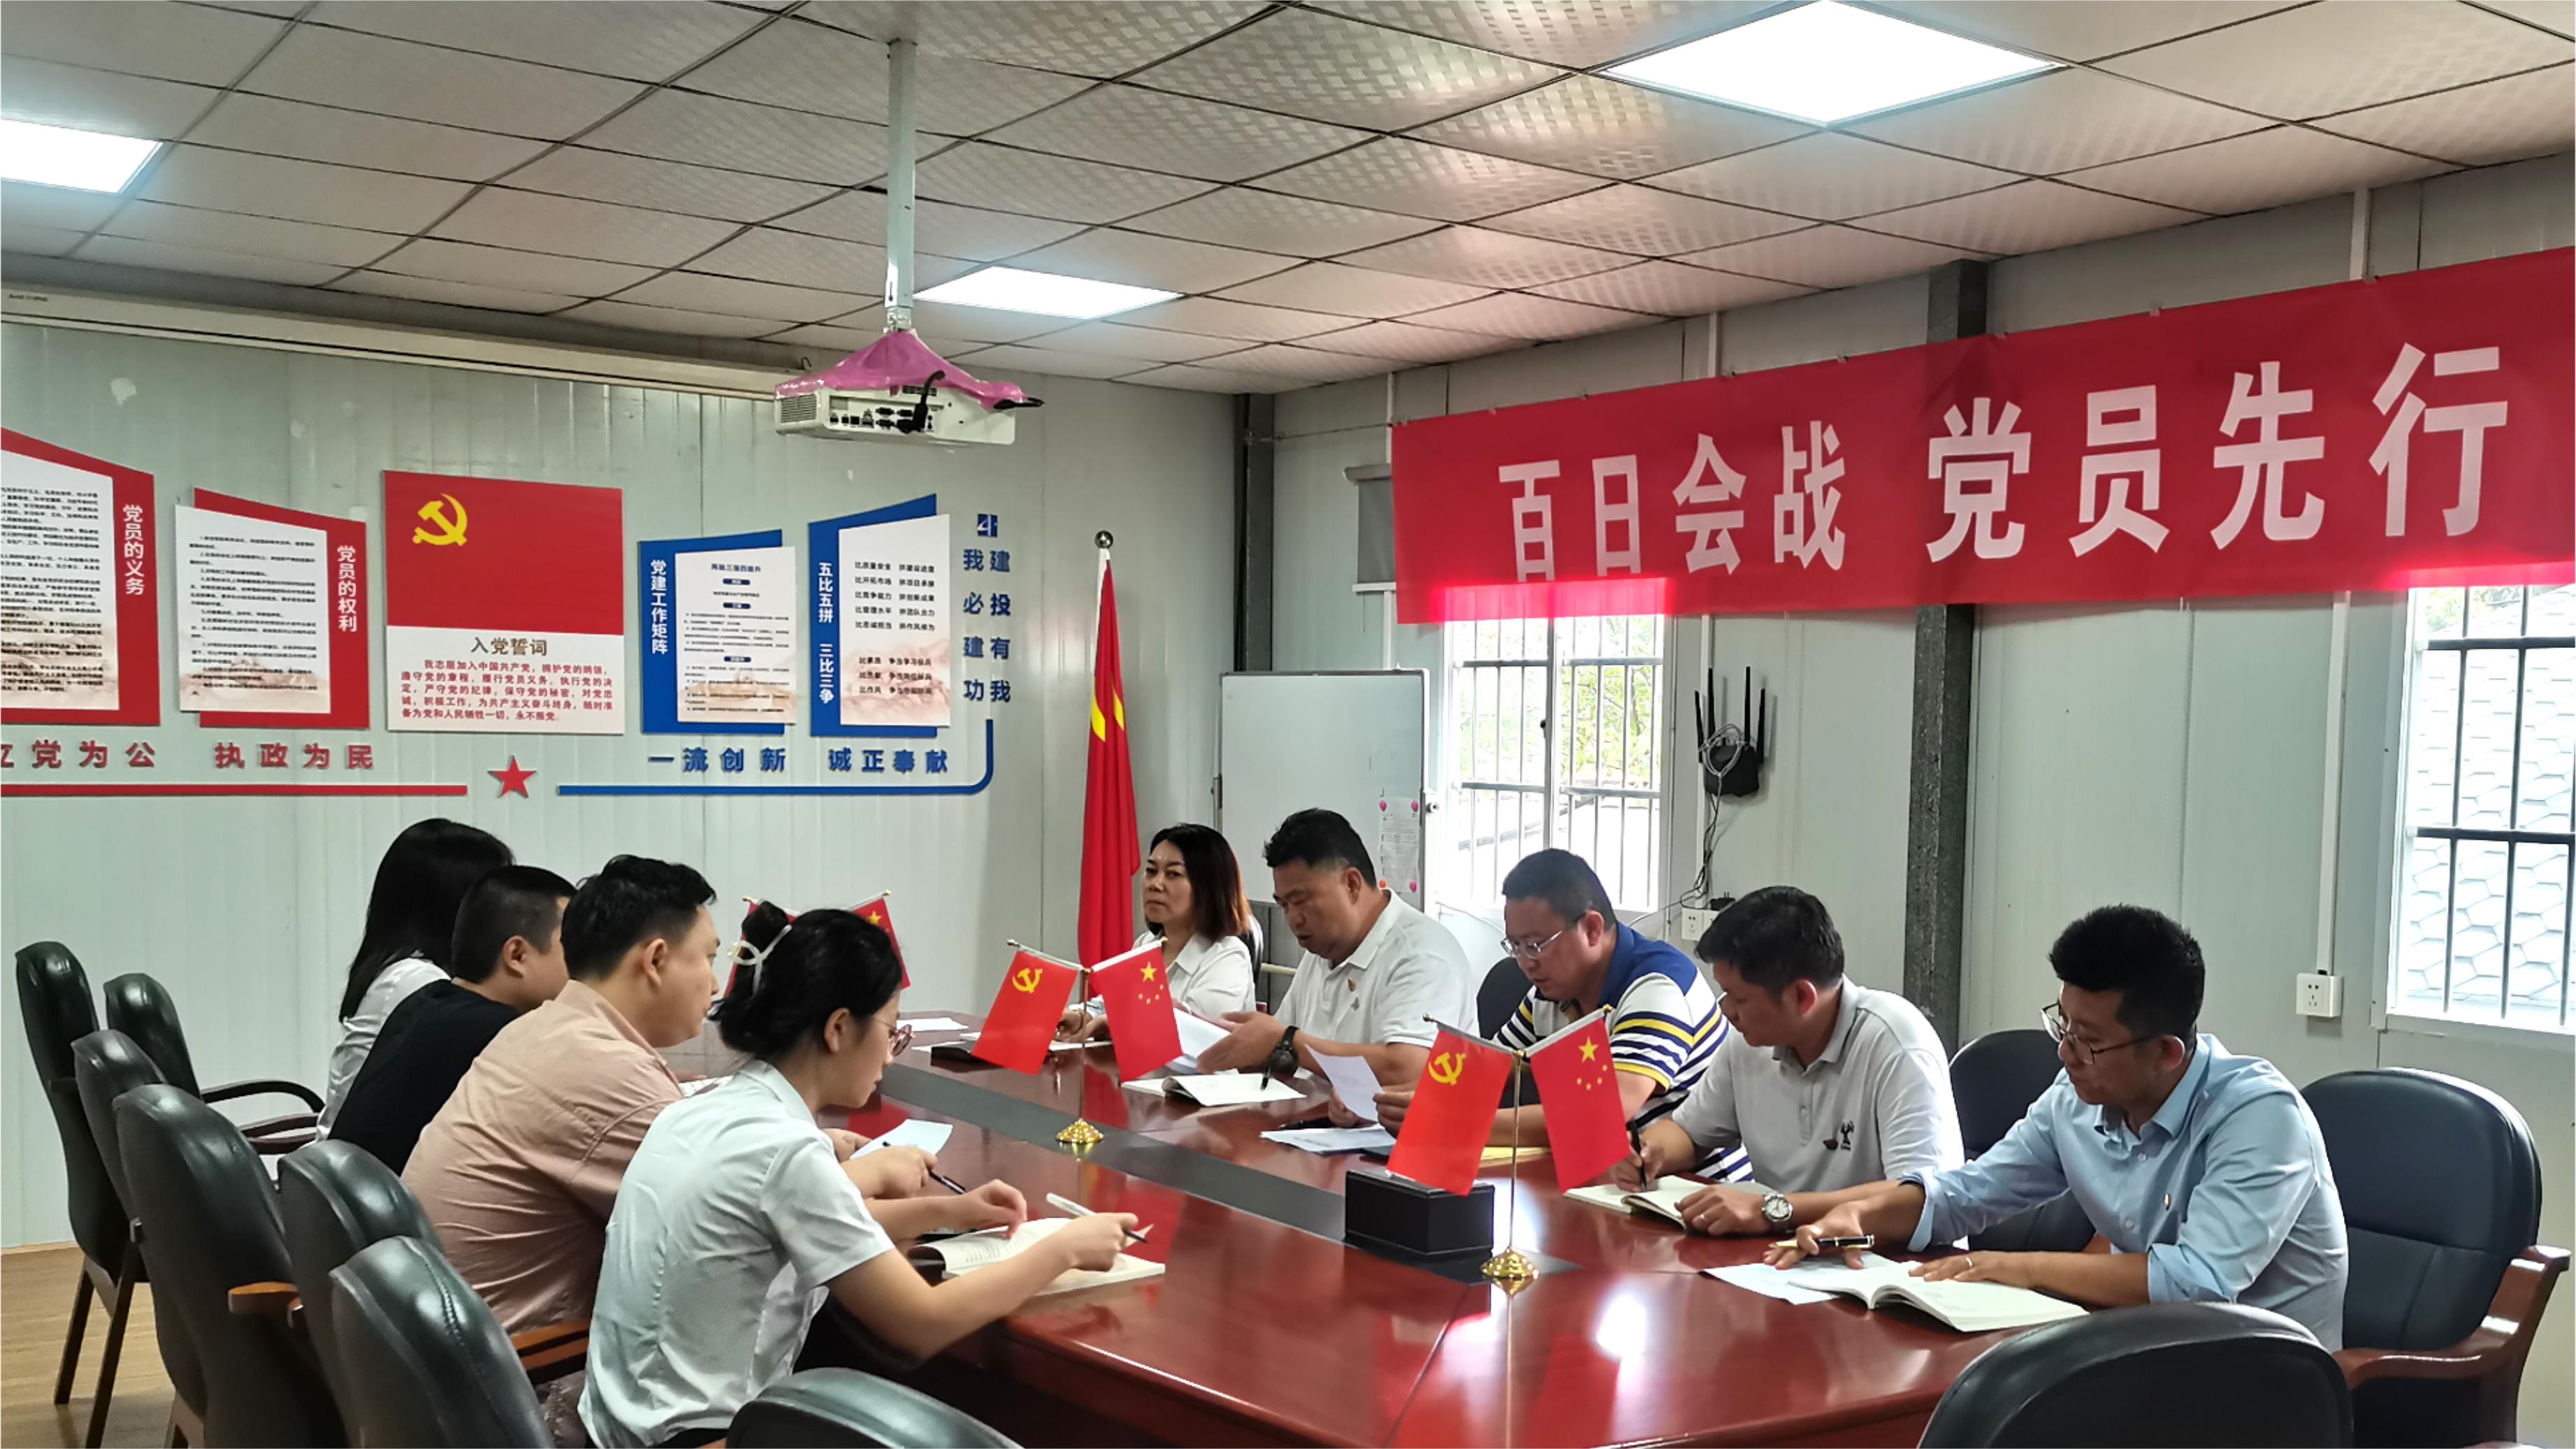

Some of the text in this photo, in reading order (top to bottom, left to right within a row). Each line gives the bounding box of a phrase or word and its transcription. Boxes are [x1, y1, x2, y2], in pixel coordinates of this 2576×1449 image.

[1499, 343, 2508, 582] 百日会战 党员先行
[123, 504, 145, 595] 党员的义务
[337, 545, 357, 632] 党员的权利
[470, 637, 548, 656] 入党誓词
[651, 558, 668, 655] 党建工作矩阵
[818, 562, 834, 704] 五比五拼 三比三争
[963, 549, 984, 702] 我必建功
[990, 550, 1011, 703] 建投有我
[214, 742, 374, 770] 执政为民
[648, 747, 948, 774] 一流创新 诚正奉献
